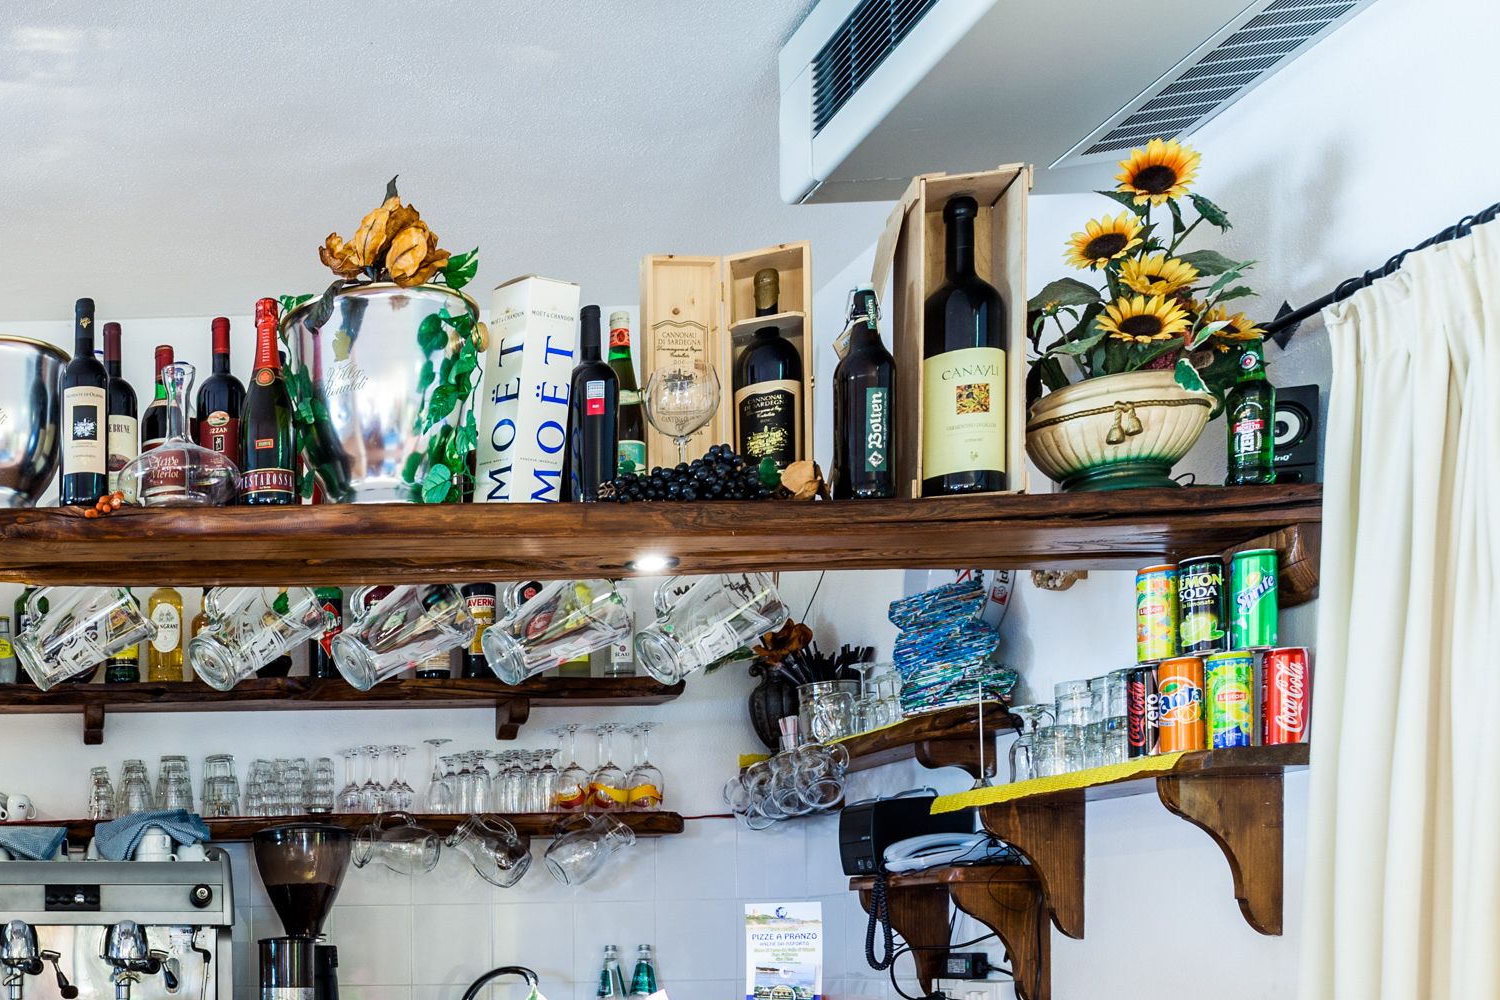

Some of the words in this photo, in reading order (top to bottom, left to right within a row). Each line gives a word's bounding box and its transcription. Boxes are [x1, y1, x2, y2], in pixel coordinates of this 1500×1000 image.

[661, 331, 697, 339] CANNONAU
[941, 364, 999, 381] CANAYLI
[486, 337, 524, 501] MOËT
[531, 335, 574, 502] MOËT
[867, 391, 883, 449] Bolten
[240, 472, 293, 490] TESTAROSSA
[467, 598, 495, 608] AVERNA
[1179, 587, 1218, 601] SODA
[1236, 575, 1274, 612] Sprite
[1158, 687, 1203, 715] anta
[1274, 659, 1304, 733] Coca-Cola
[1147, 693, 1159, 729] zero
[784, 932, 818, 940] PRANZO
